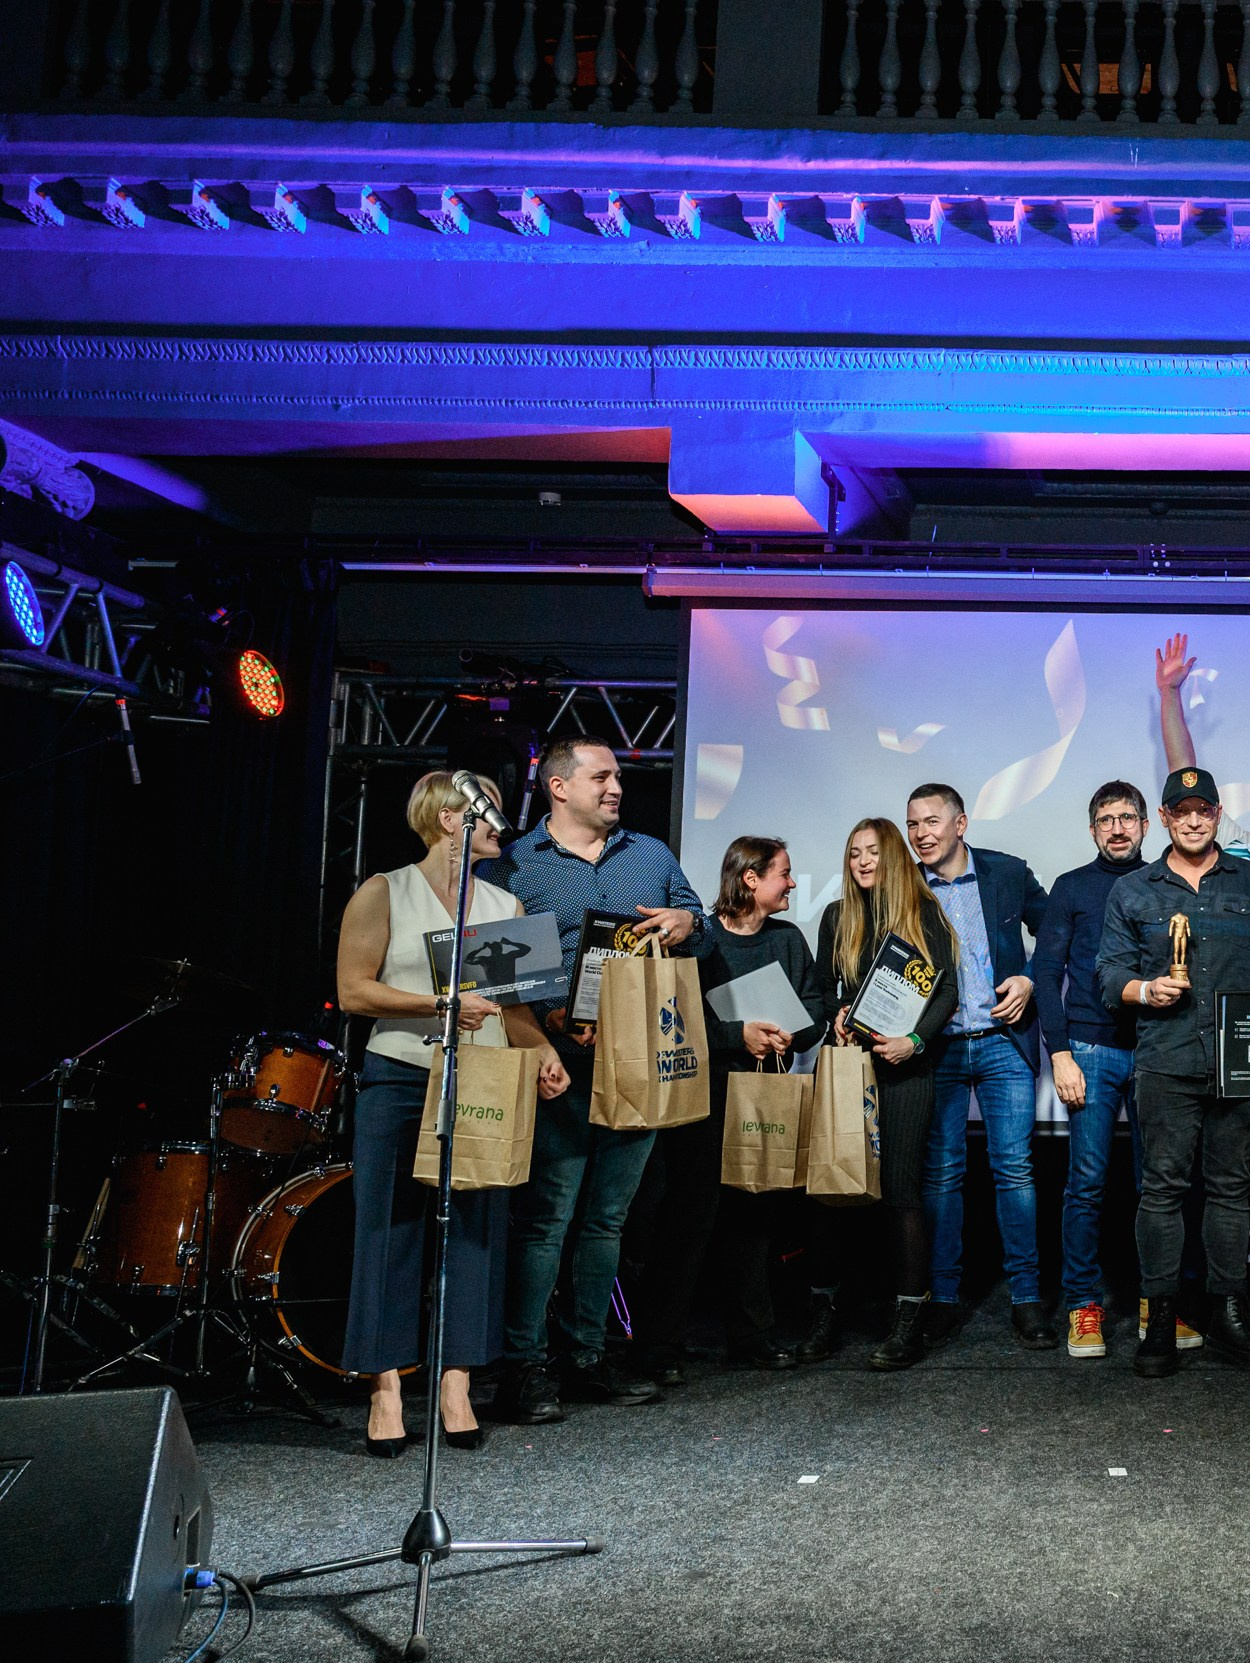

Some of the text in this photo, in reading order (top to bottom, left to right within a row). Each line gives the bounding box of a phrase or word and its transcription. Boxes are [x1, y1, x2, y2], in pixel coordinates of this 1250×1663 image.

[881, 965, 920, 994] ДИПЛОМ
[912, 965, 932, 992] 100
[656, 1056, 698, 1074] WORLD
[455, 1103, 504, 1122] evrana
[742, 1120, 786, 1135] levrana
